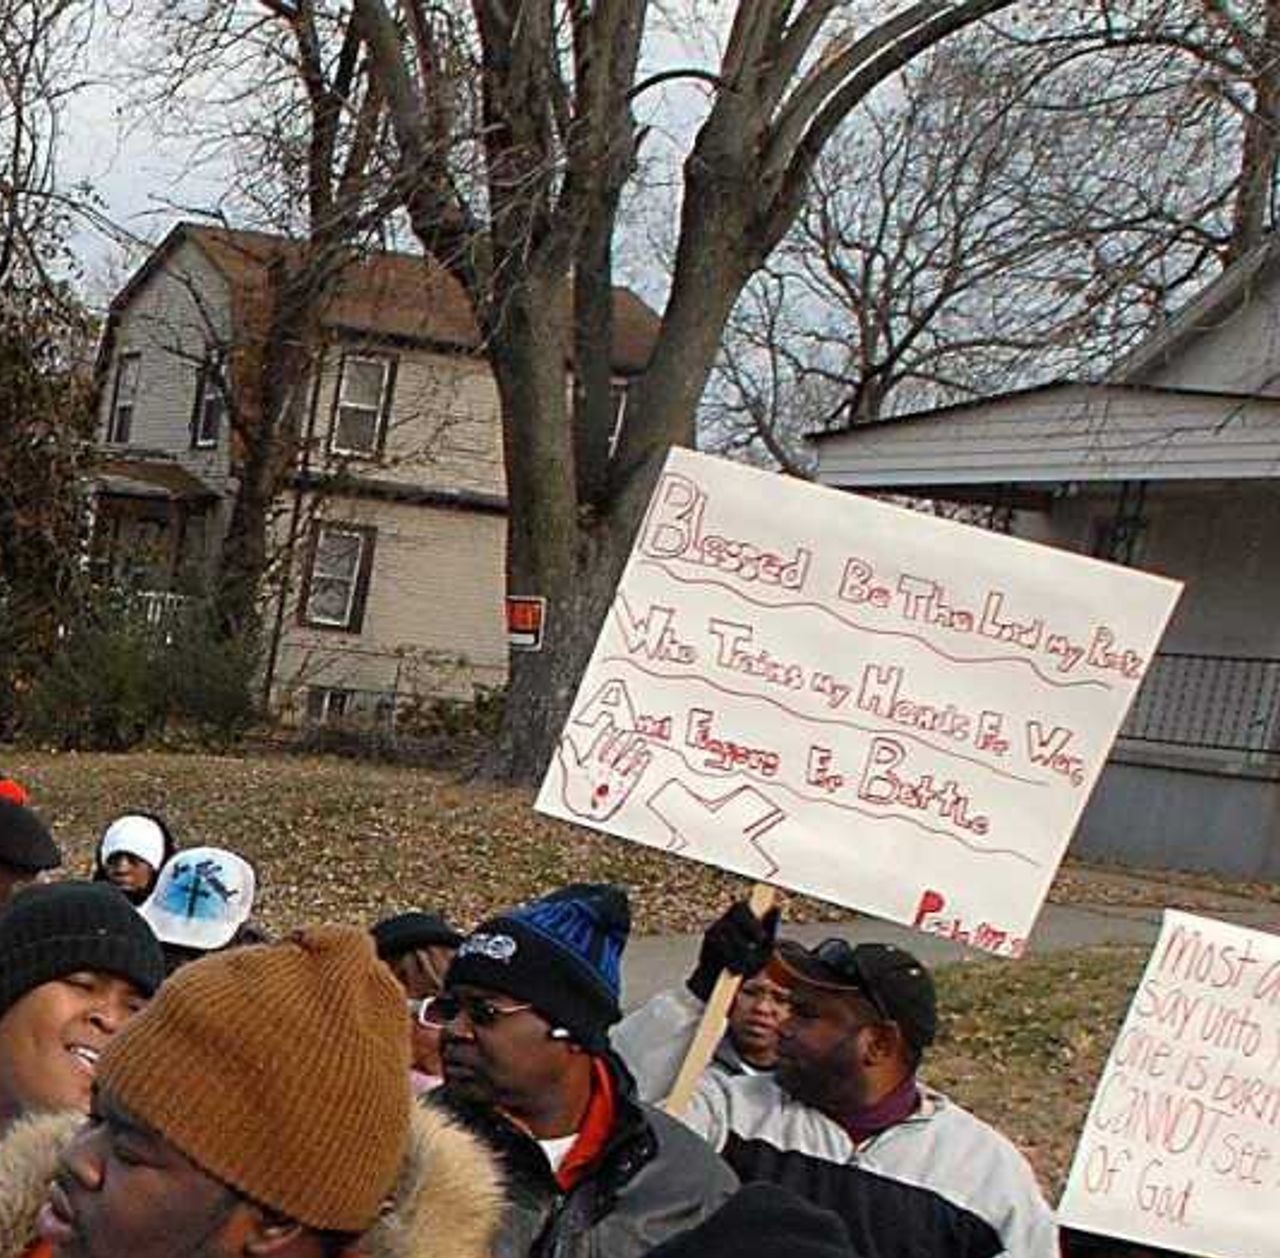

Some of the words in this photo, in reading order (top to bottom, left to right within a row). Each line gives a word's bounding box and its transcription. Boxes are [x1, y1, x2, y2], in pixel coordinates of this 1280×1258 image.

[639, 472, 812, 592] Blessed
[840, 556, 893, 608] Be
[611, 592, 696, 664] Who
[573, 680, 672, 741] And
